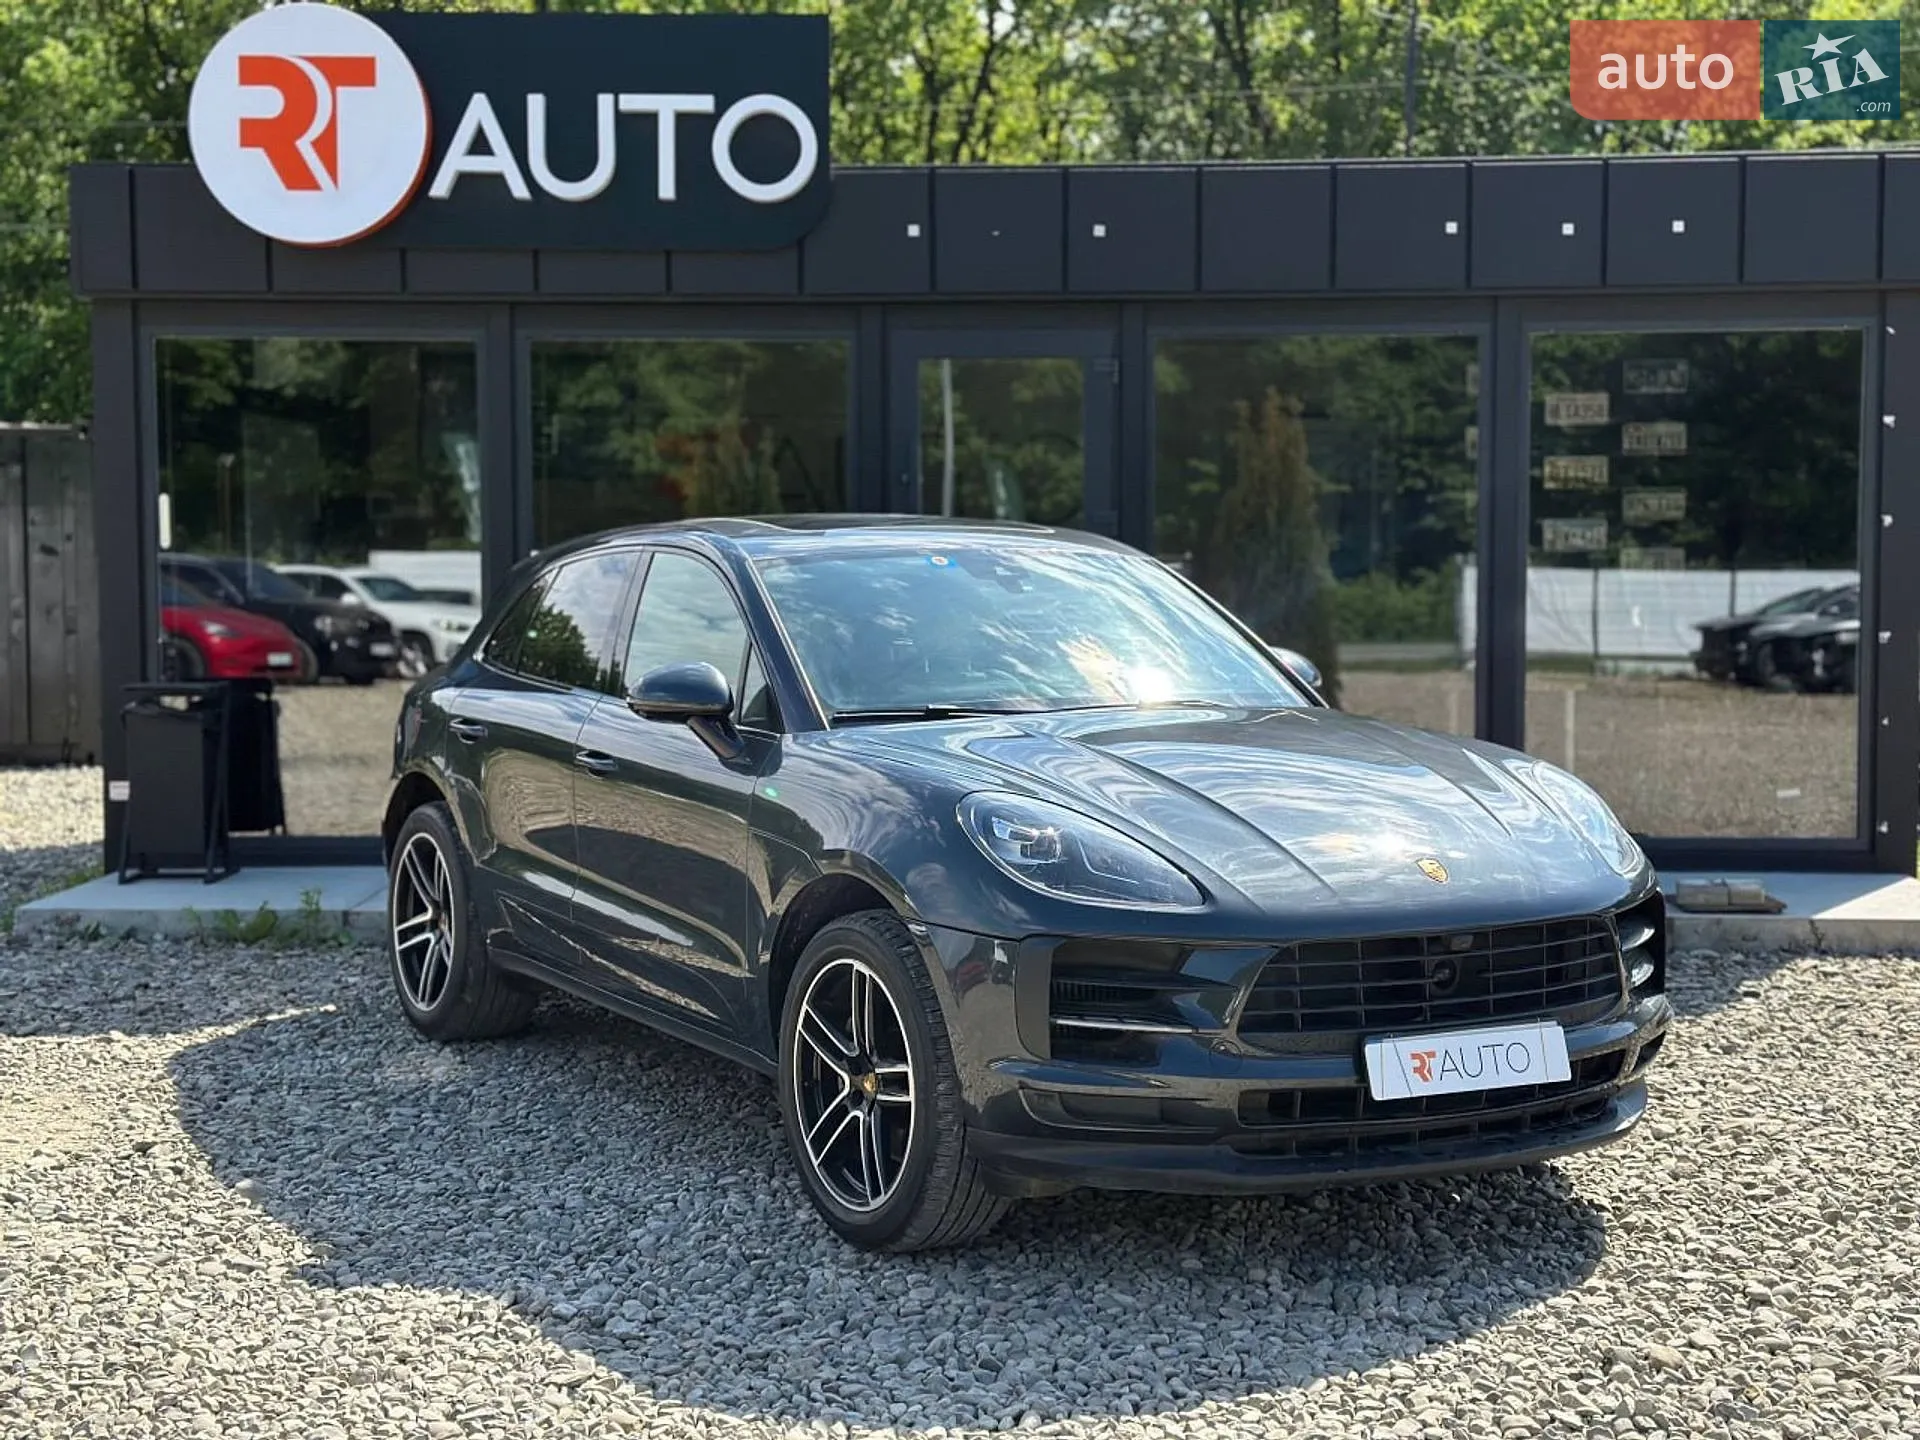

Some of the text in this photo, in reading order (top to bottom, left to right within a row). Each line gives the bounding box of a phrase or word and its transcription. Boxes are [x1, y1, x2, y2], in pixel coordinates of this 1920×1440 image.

[238, 55, 818, 203] RT AUTO
[1409, 1042, 1531, 1083] RT AUTO
